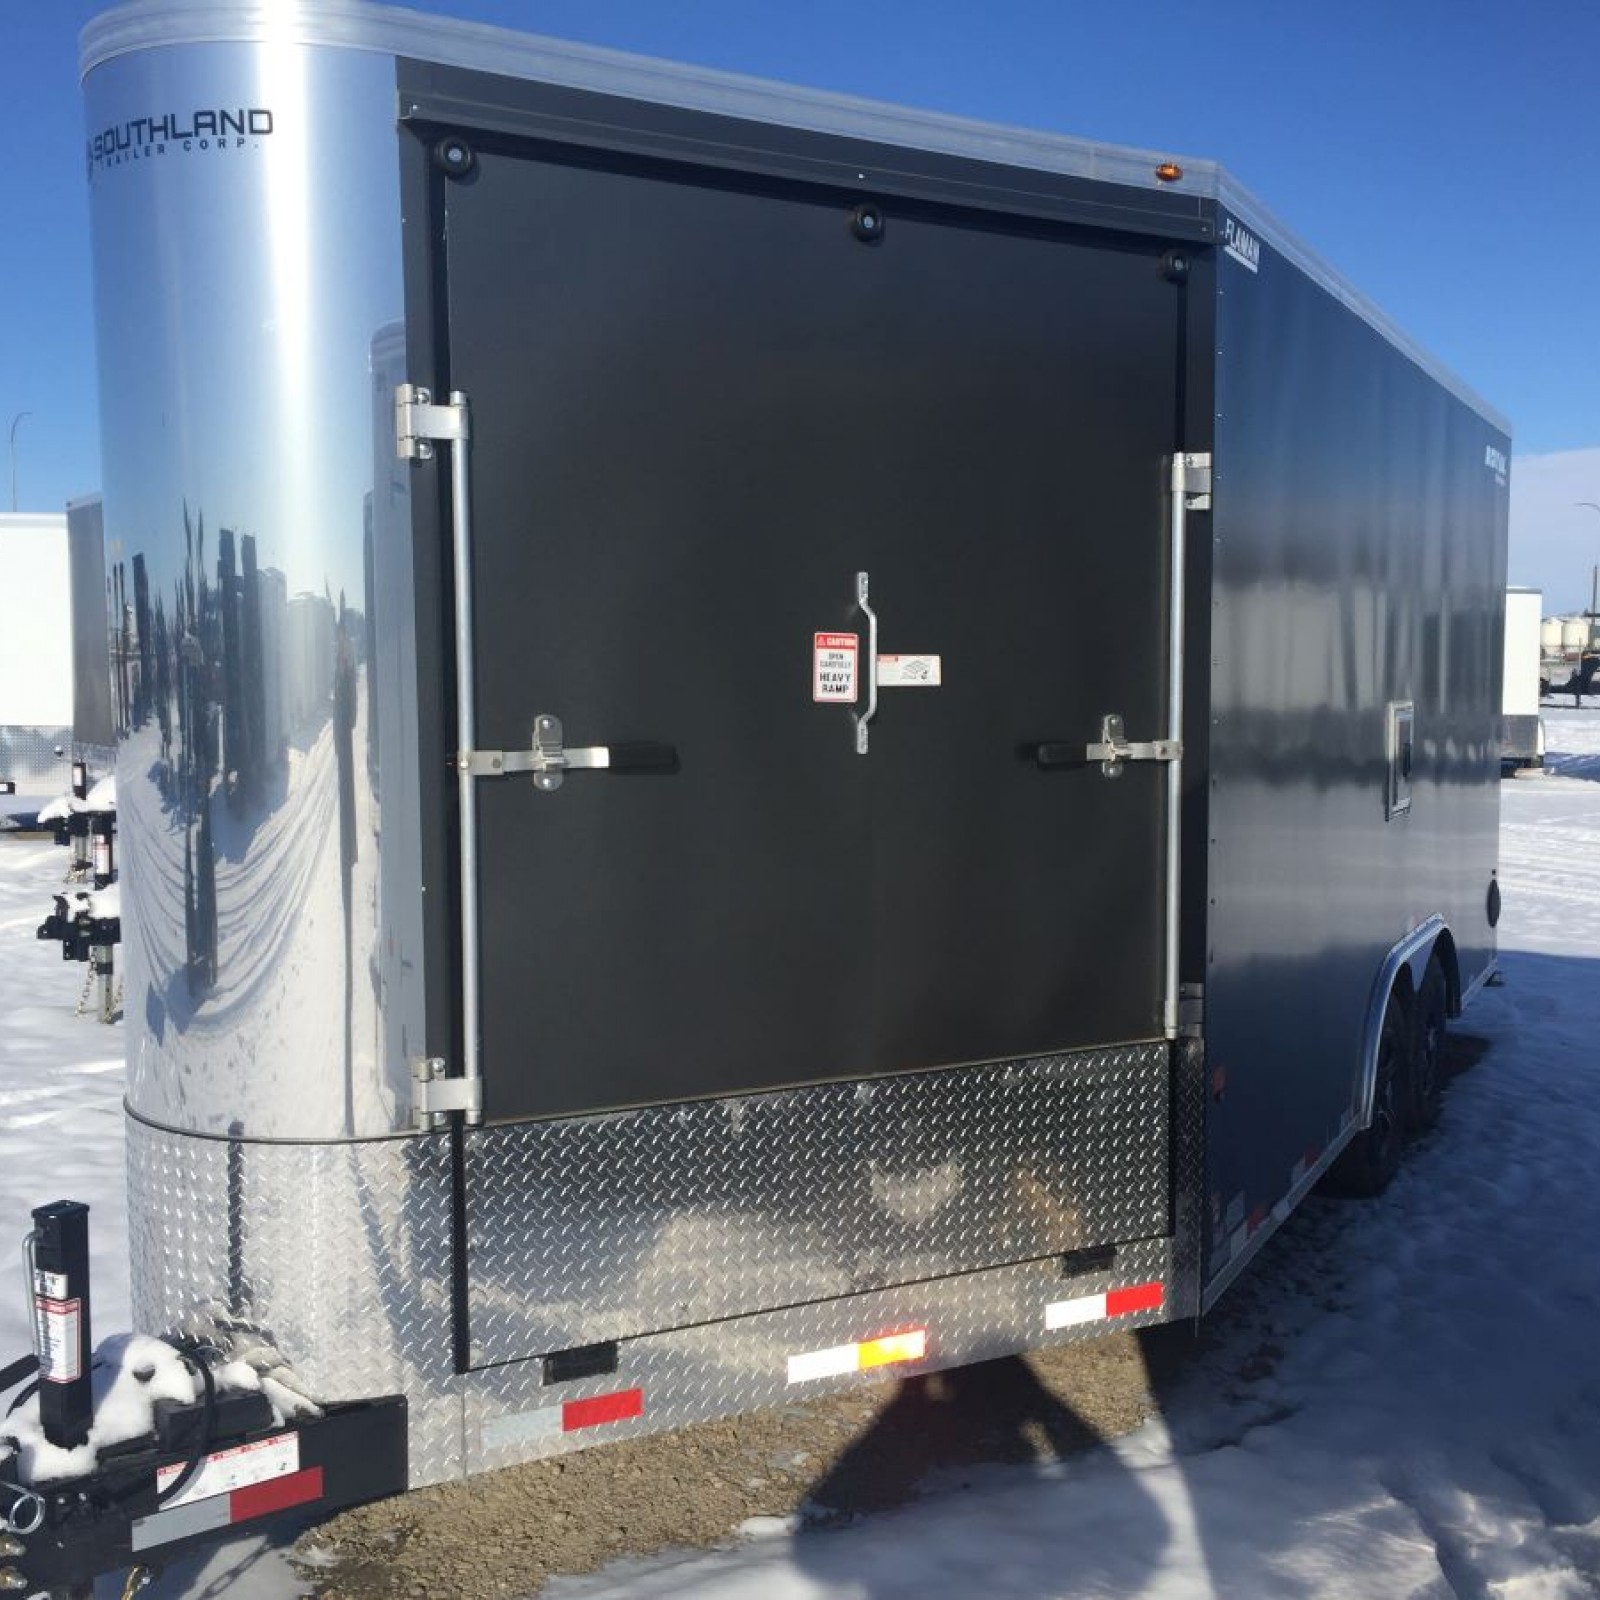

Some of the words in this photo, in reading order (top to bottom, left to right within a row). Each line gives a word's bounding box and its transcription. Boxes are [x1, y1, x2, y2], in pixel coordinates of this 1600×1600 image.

[94, 109, 274, 161] SOUTHLAND
[182, 138, 259, 153] CORP.
[1225, 218, 1260, 266] FLAMAN
[819, 672, 851, 682] HEAVY
[822, 684, 849, 694] RAMP
